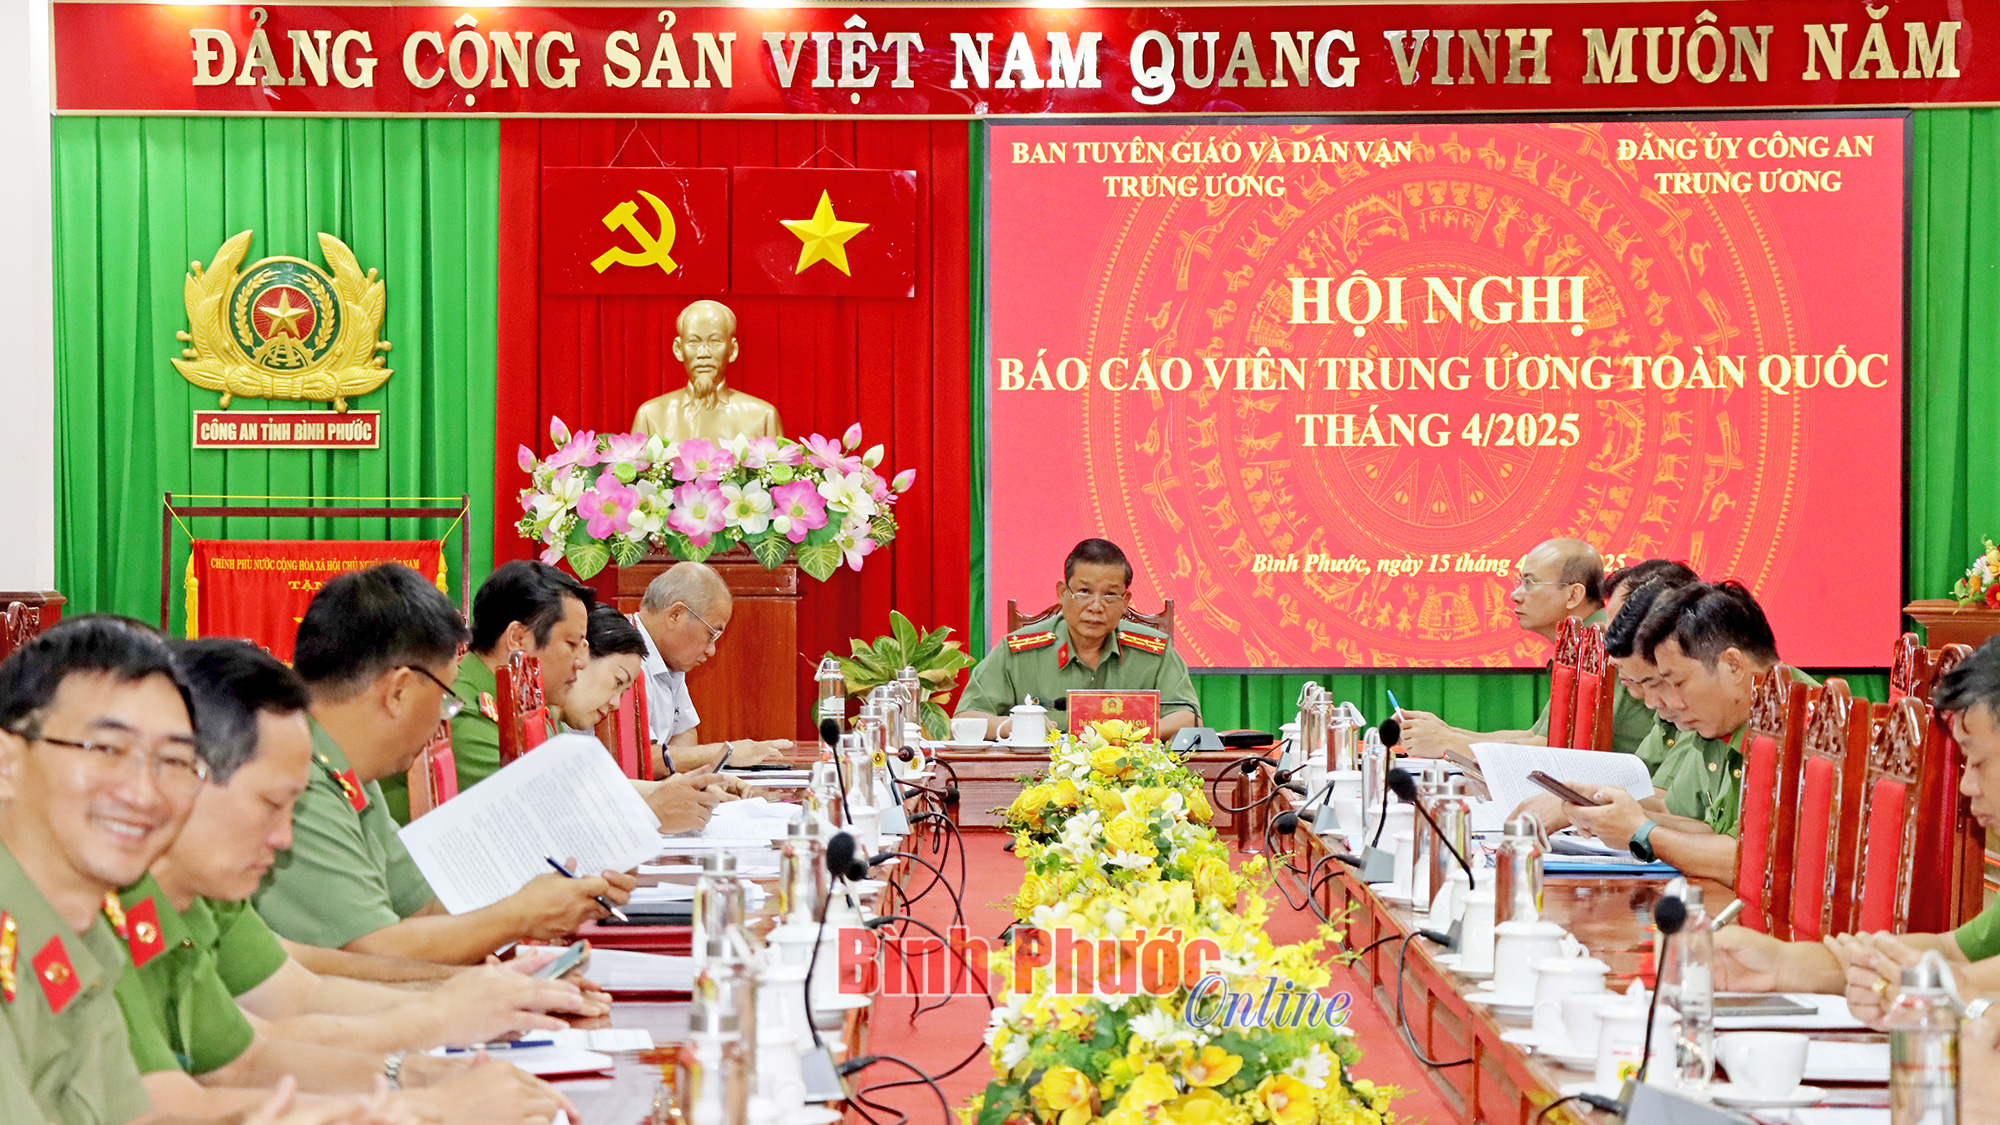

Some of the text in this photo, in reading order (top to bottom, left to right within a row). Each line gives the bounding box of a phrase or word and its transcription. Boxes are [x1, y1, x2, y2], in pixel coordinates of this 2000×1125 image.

[190, 4, 1962, 106] ĐẢNG CỘNG SẢN VIỆT NAM QUANG VINH MUÔN NĂM
[1011, 135, 1413, 168] BAN TUYÊN GIÁO VÀ DÂN VẬN
[1617, 131, 1874, 160] ĐẢNG ỦY CÔNG AN
[1102, 172, 1286, 197] TRUNG ƯƠNG
[1654, 167, 1843, 194] TRUNG ƯƠNG
[1287, 270, 1589, 338] HỘI NGHỊ
[997, 344, 1889, 395] BÁO CÁO VIÊN TRUNG ƯƠNG TOÀN QUỐC
[200, 418, 372, 441] CÔNG AN TỈNH BÌNH PHƯỚC
[1296, 404, 1580, 447] THÁNG 4/2025
[210, 556, 235, 569] CHÍNH
[237, 555, 252, 570] PHỦ
[254, 556, 275, 570] NƯỚC
[276, 556, 297, 573] CỘNG
[327, 557, 340, 573] HỘI
[342, 556, 358, 571] CHỦ
[1251, 553, 1299, 573] Bình
[1303, 553, 1371, 575] Phước,
[1376, 554, 1423, 577] ngày
[1427, 553, 1451, 572] 15
[1454, 553, 1511, 577] tháng
[1601, 553, 1627, 572] 25
